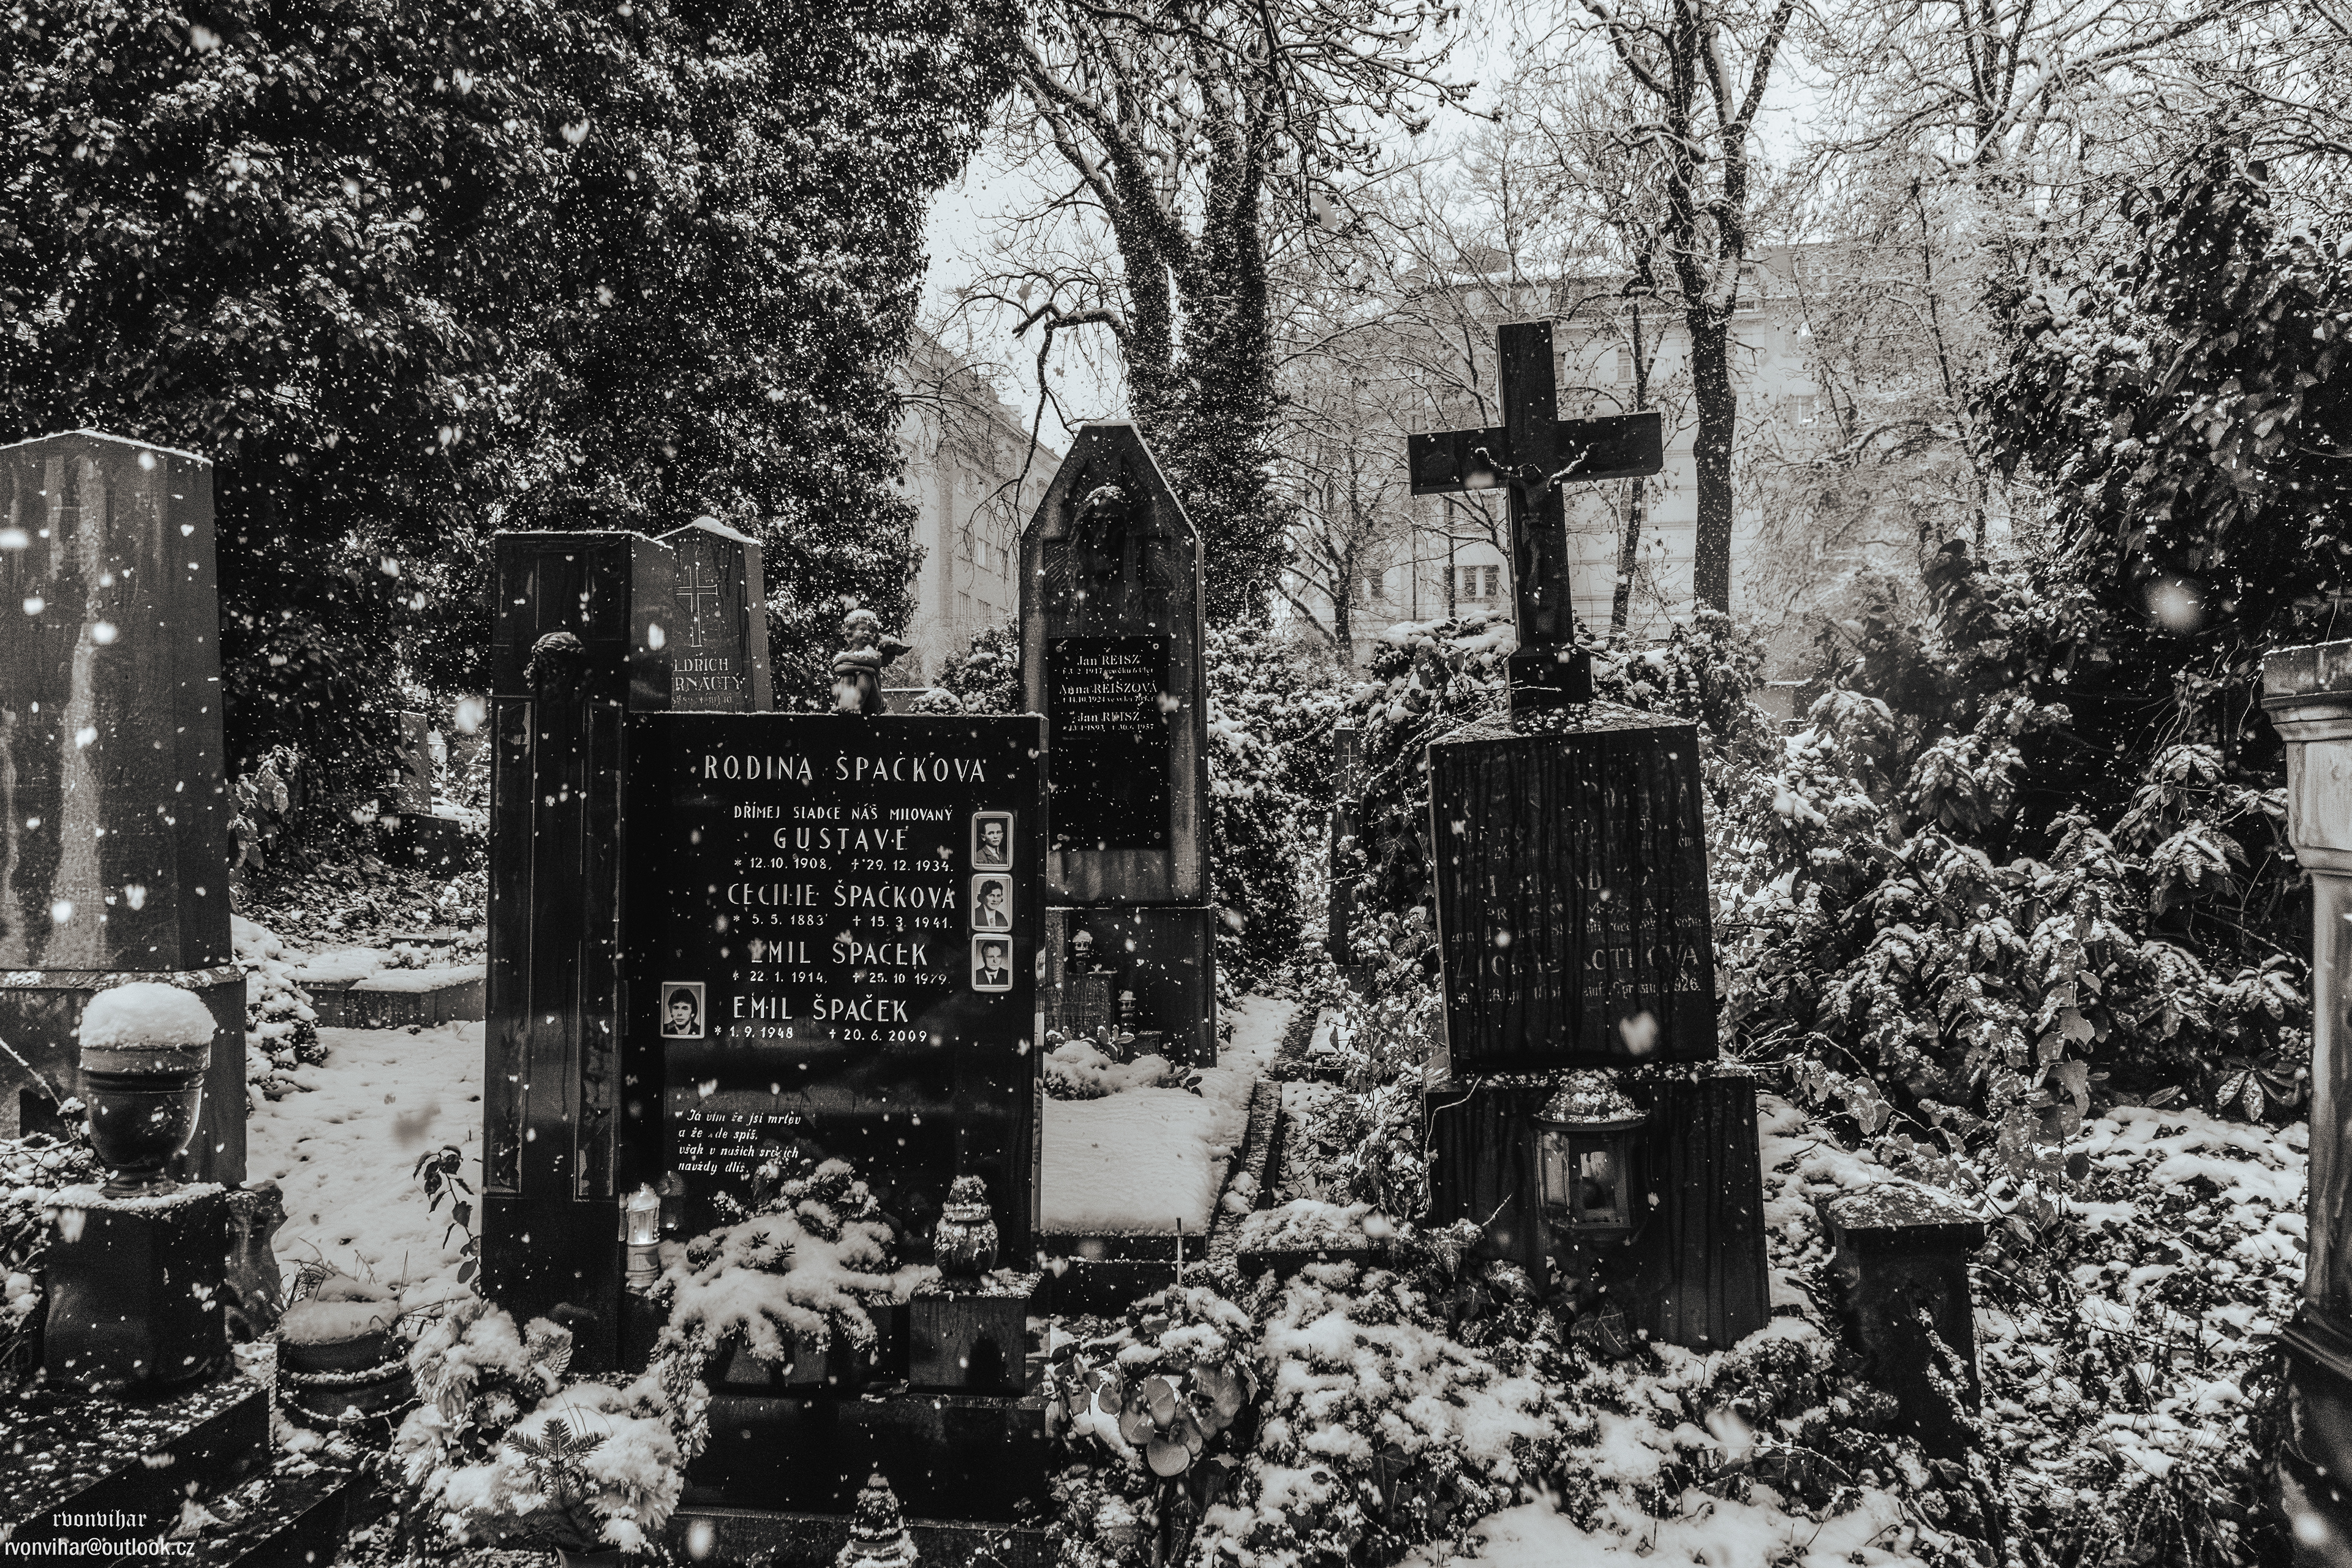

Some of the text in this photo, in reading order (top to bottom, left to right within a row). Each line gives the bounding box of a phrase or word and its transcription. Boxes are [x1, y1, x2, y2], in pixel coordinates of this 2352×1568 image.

[1077, 655, 1140, 666] Jan REISZ
[1060, 684, 1089, 694] Anna
[1077, 712, 1098, 722] Jan
[705, 755, 813, 780] RODINA
[734, 801, 952, 821] DŘÍMEJ SLADCE NÁŠ MILOVANÝ
[774, 827, 908, 850] GUSTAVE
[728, 879, 955, 908] CECILIE ŠPAČKOVÁ
[734, 993, 908, 1022] EMIL ŠPAČEK
[761, 1027, 793, 1038] 1948
[888, 1030, 927, 1042] 2009
[687, 1109, 701, 1121] Já
[746, 1112, 764, 1126] jsi
[678, 1129, 686, 1137] a
[678, 1161, 717, 1175] navždy
